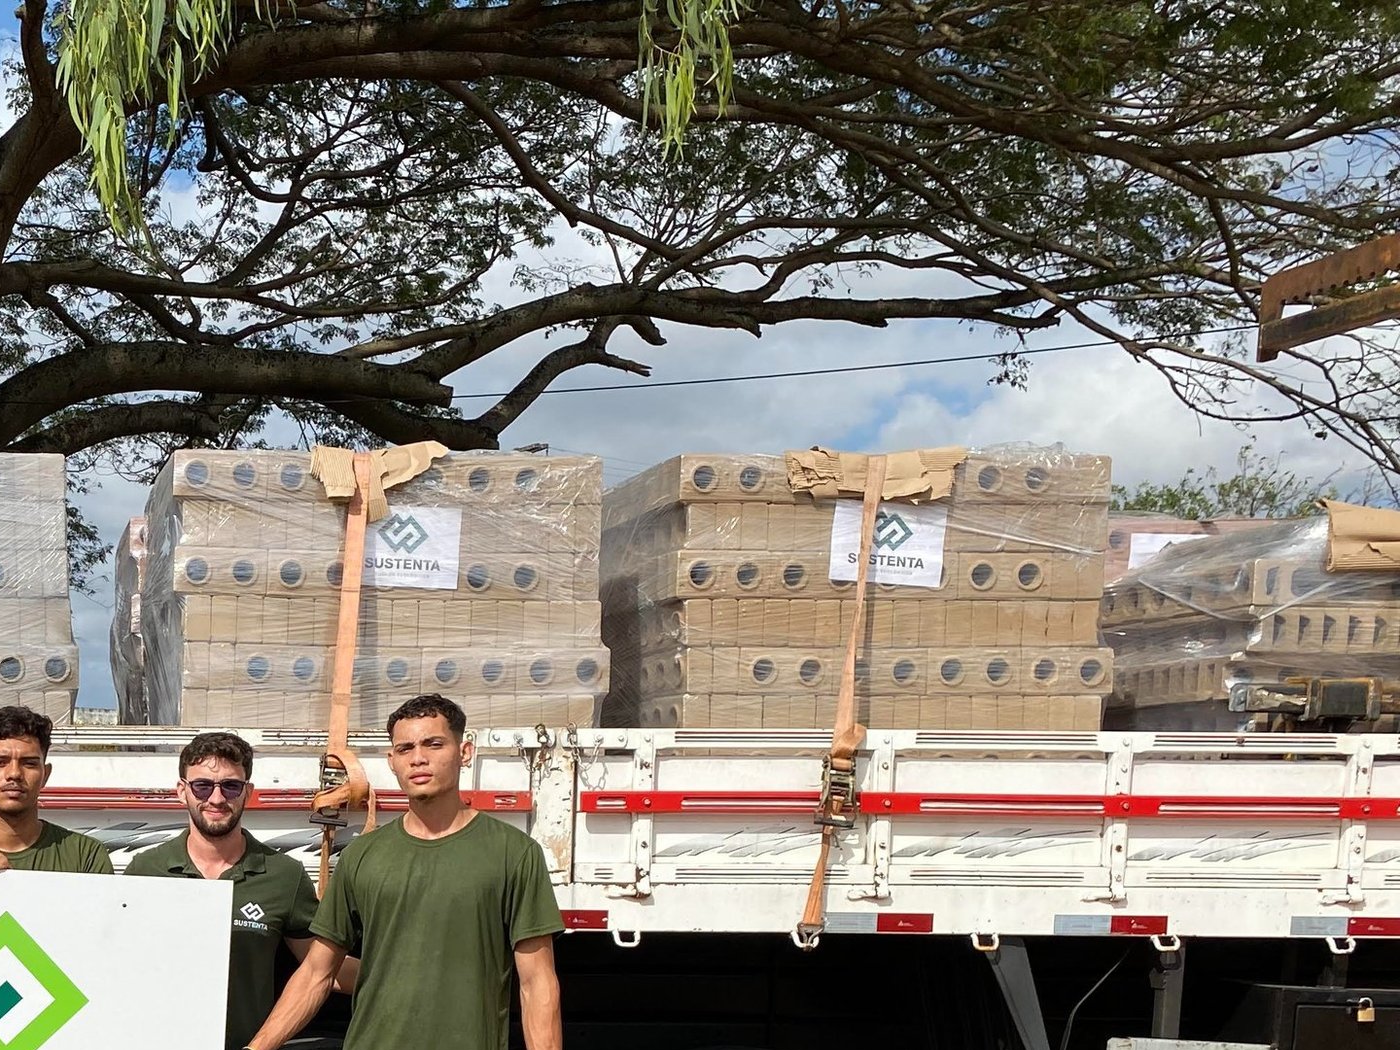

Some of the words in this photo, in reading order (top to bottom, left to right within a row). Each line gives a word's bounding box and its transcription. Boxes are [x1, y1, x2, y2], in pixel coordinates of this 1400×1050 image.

[364, 557, 441, 571] SUSTENTA
[848, 553, 924, 569] SSTENTA
[233, 919, 268, 931] SUSTENTA
